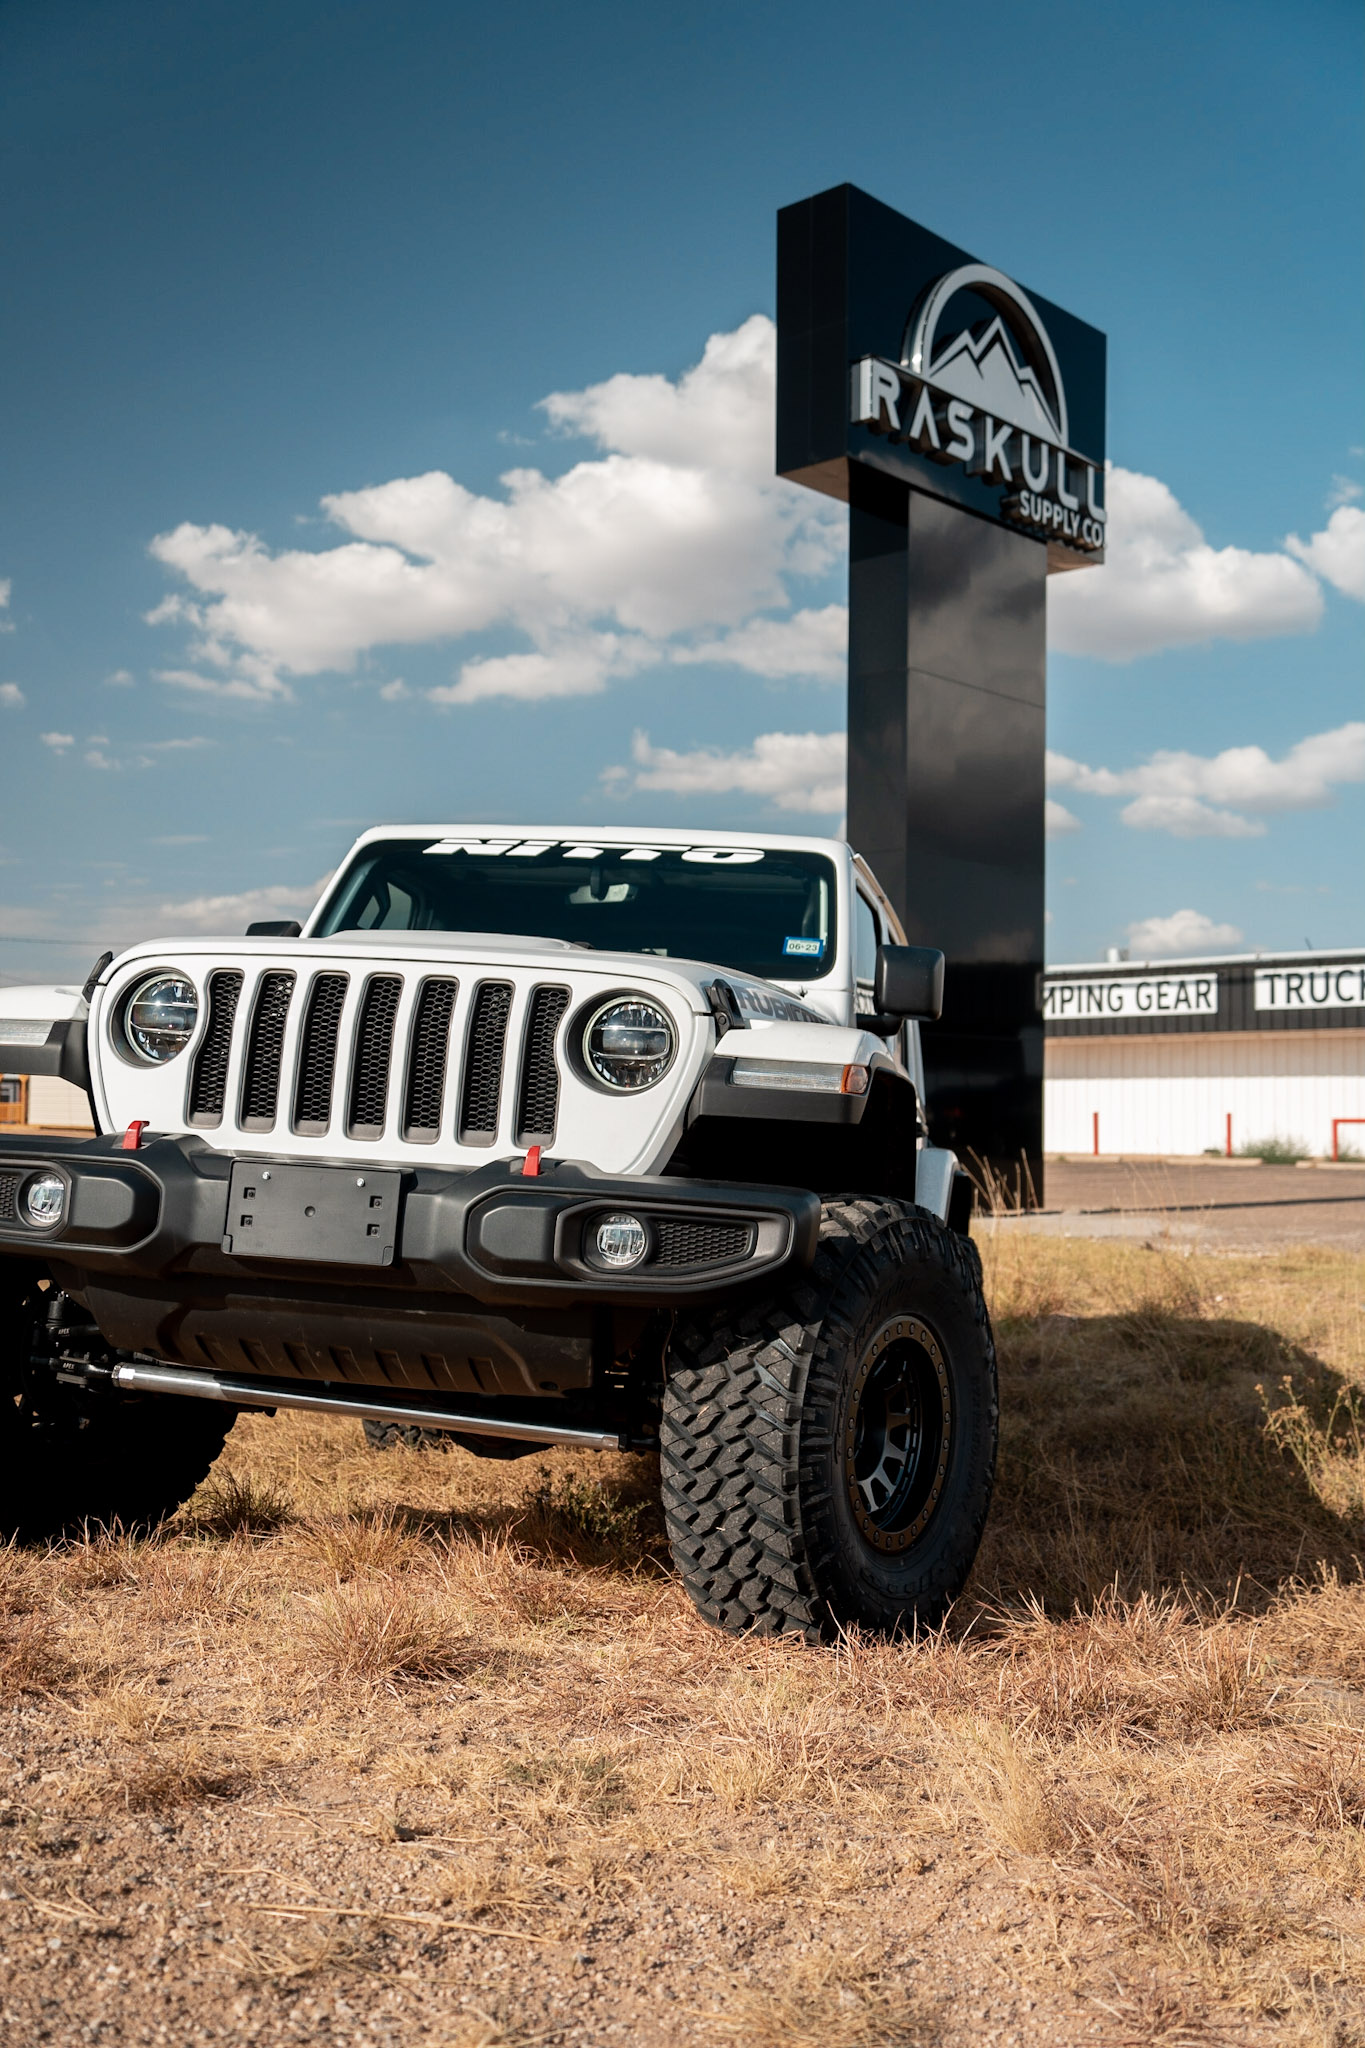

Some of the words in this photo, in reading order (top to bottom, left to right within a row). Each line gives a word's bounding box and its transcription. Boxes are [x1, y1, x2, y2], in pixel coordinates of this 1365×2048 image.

[870, 356, 1107, 524] RASKULL
[1019, 489, 1081, 538] SUPPLY
[422, 838, 765, 864] NITTO
[1135, 978, 1212, 1011] GEAR
[1263, 969, 1365, 1005] TRUC
